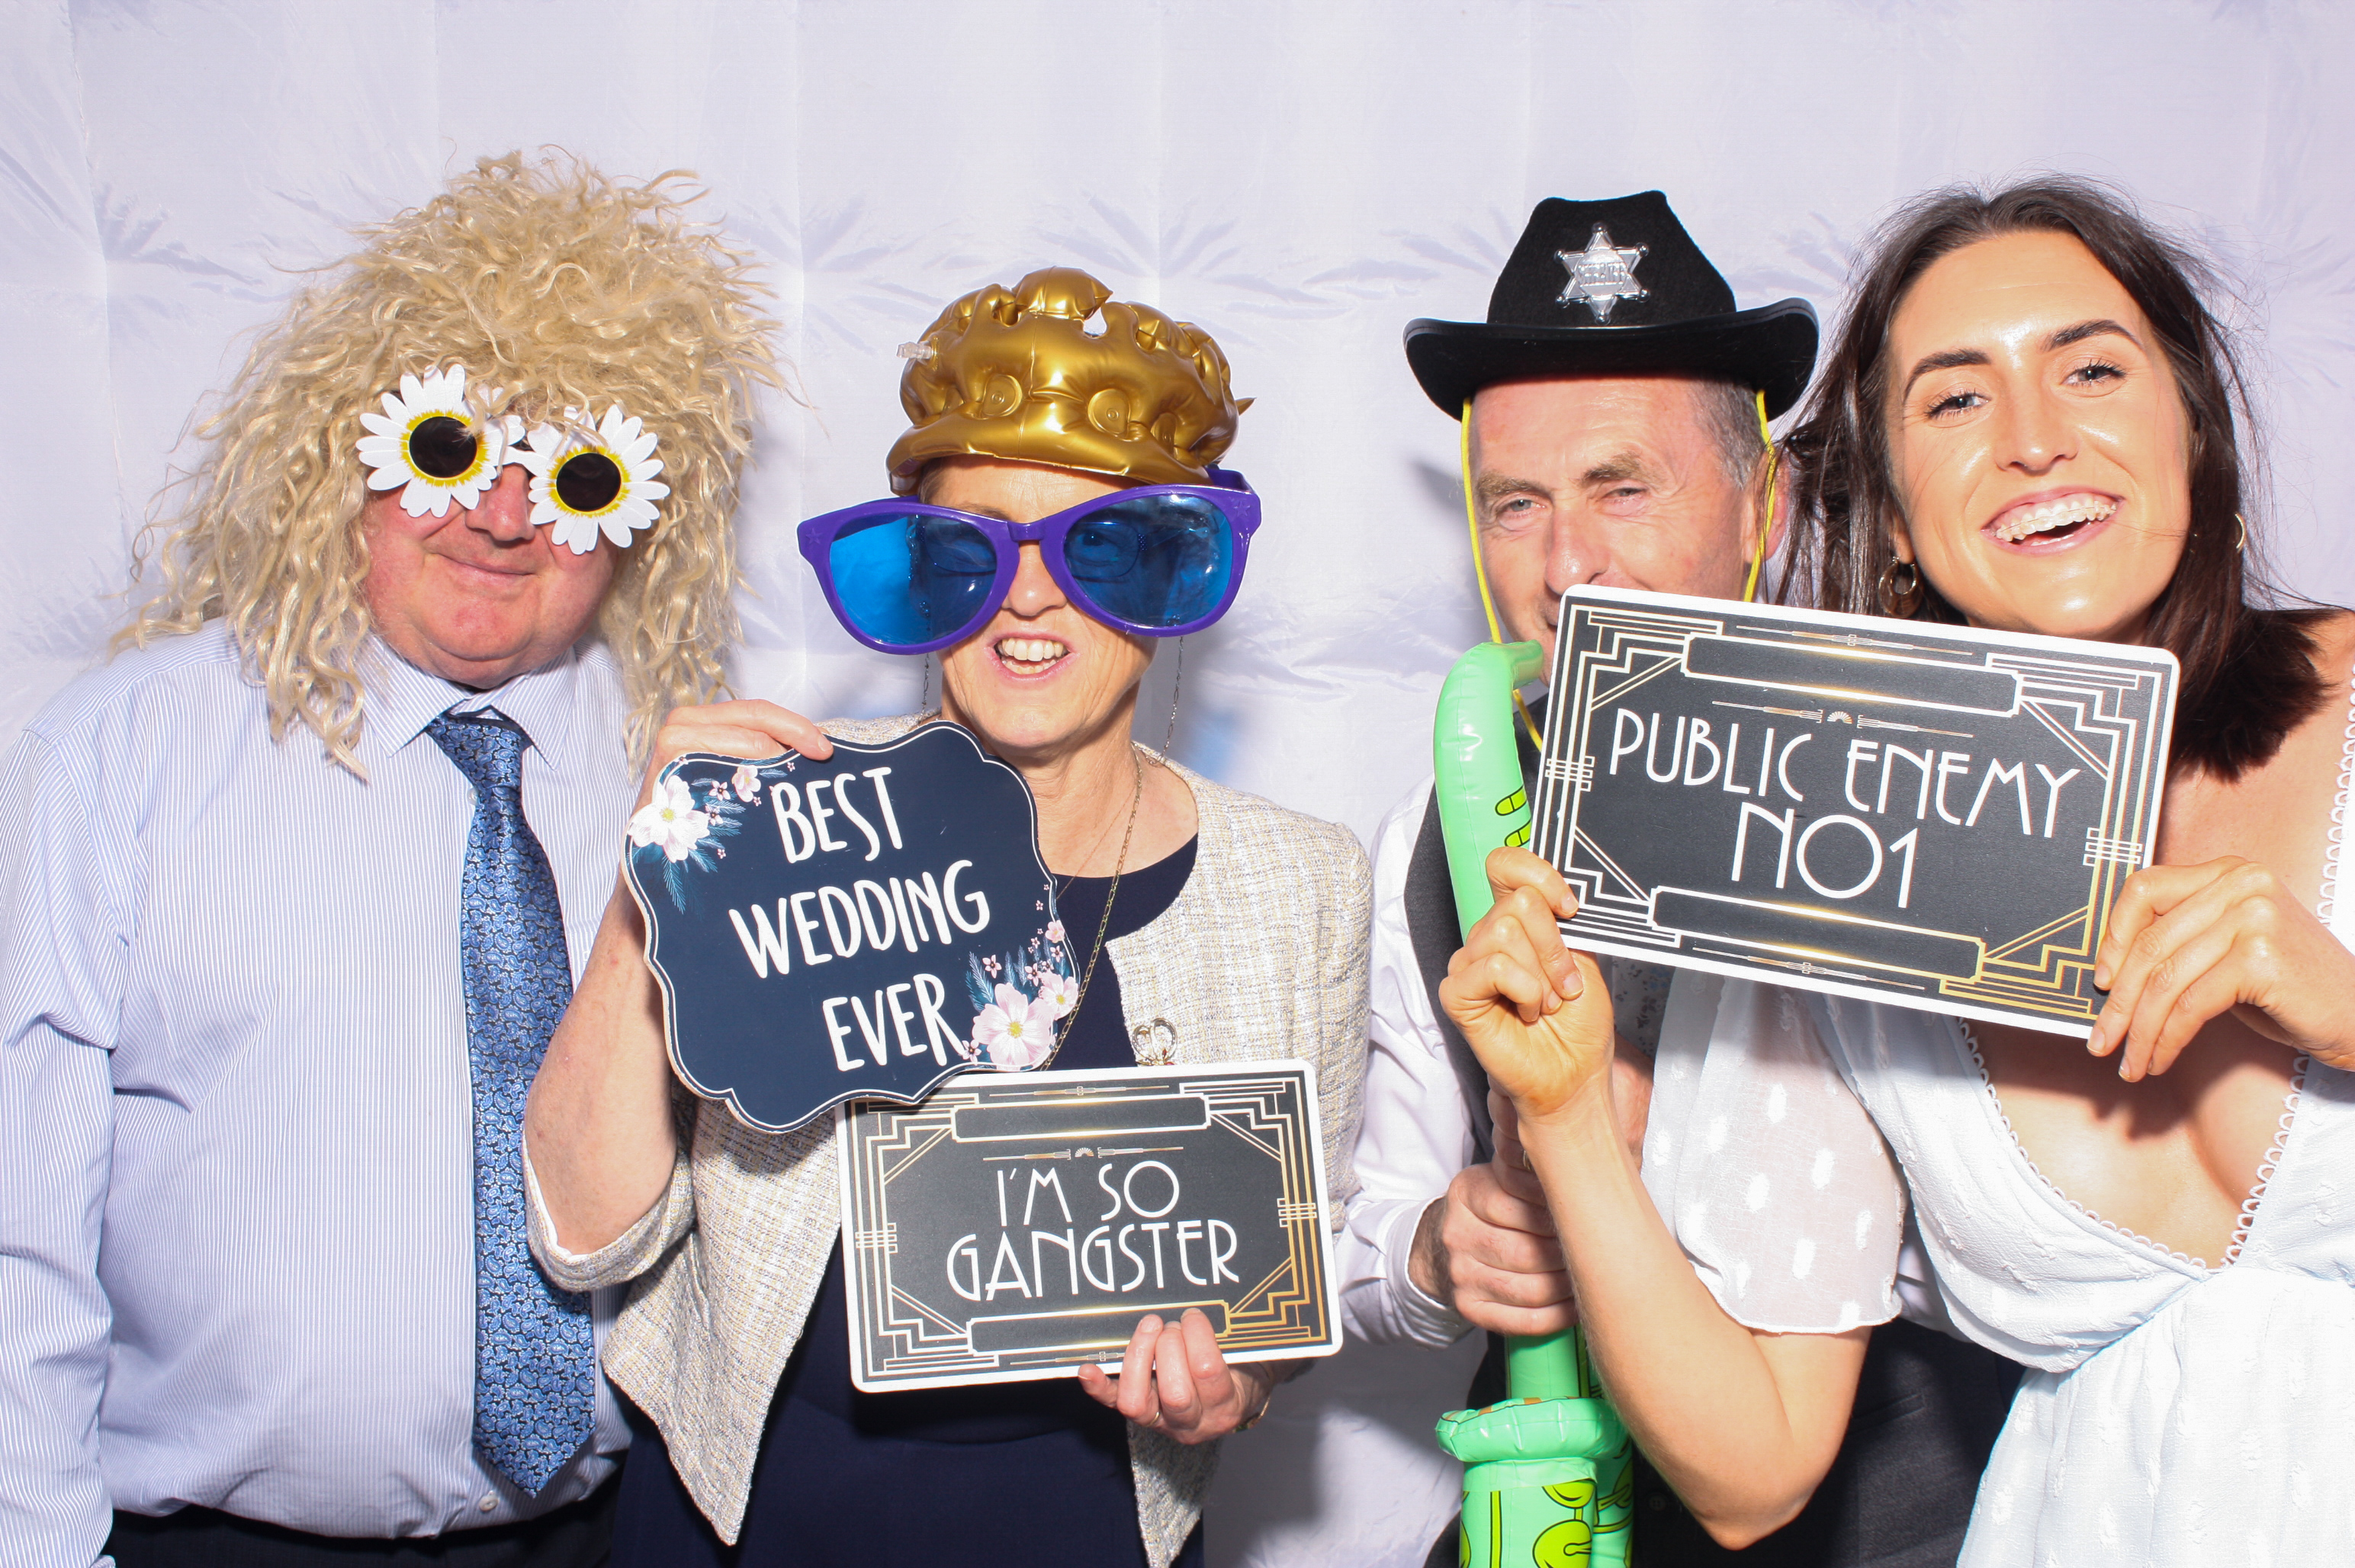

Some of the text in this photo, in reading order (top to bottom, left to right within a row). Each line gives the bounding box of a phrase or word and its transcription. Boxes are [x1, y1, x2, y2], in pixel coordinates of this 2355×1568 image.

[771, 767, 902, 863] BEST
[1610, 708, 2080, 838] PUBLIC ENEMY
[1732, 802, 1918, 908] NO1
[729, 860, 990, 978] WEDDING
[823, 974, 965, 1072] EVER
[998, 1161, 1179, 1226] I'M SO
[946, 1219, 1240, 1301] GANGSTER
